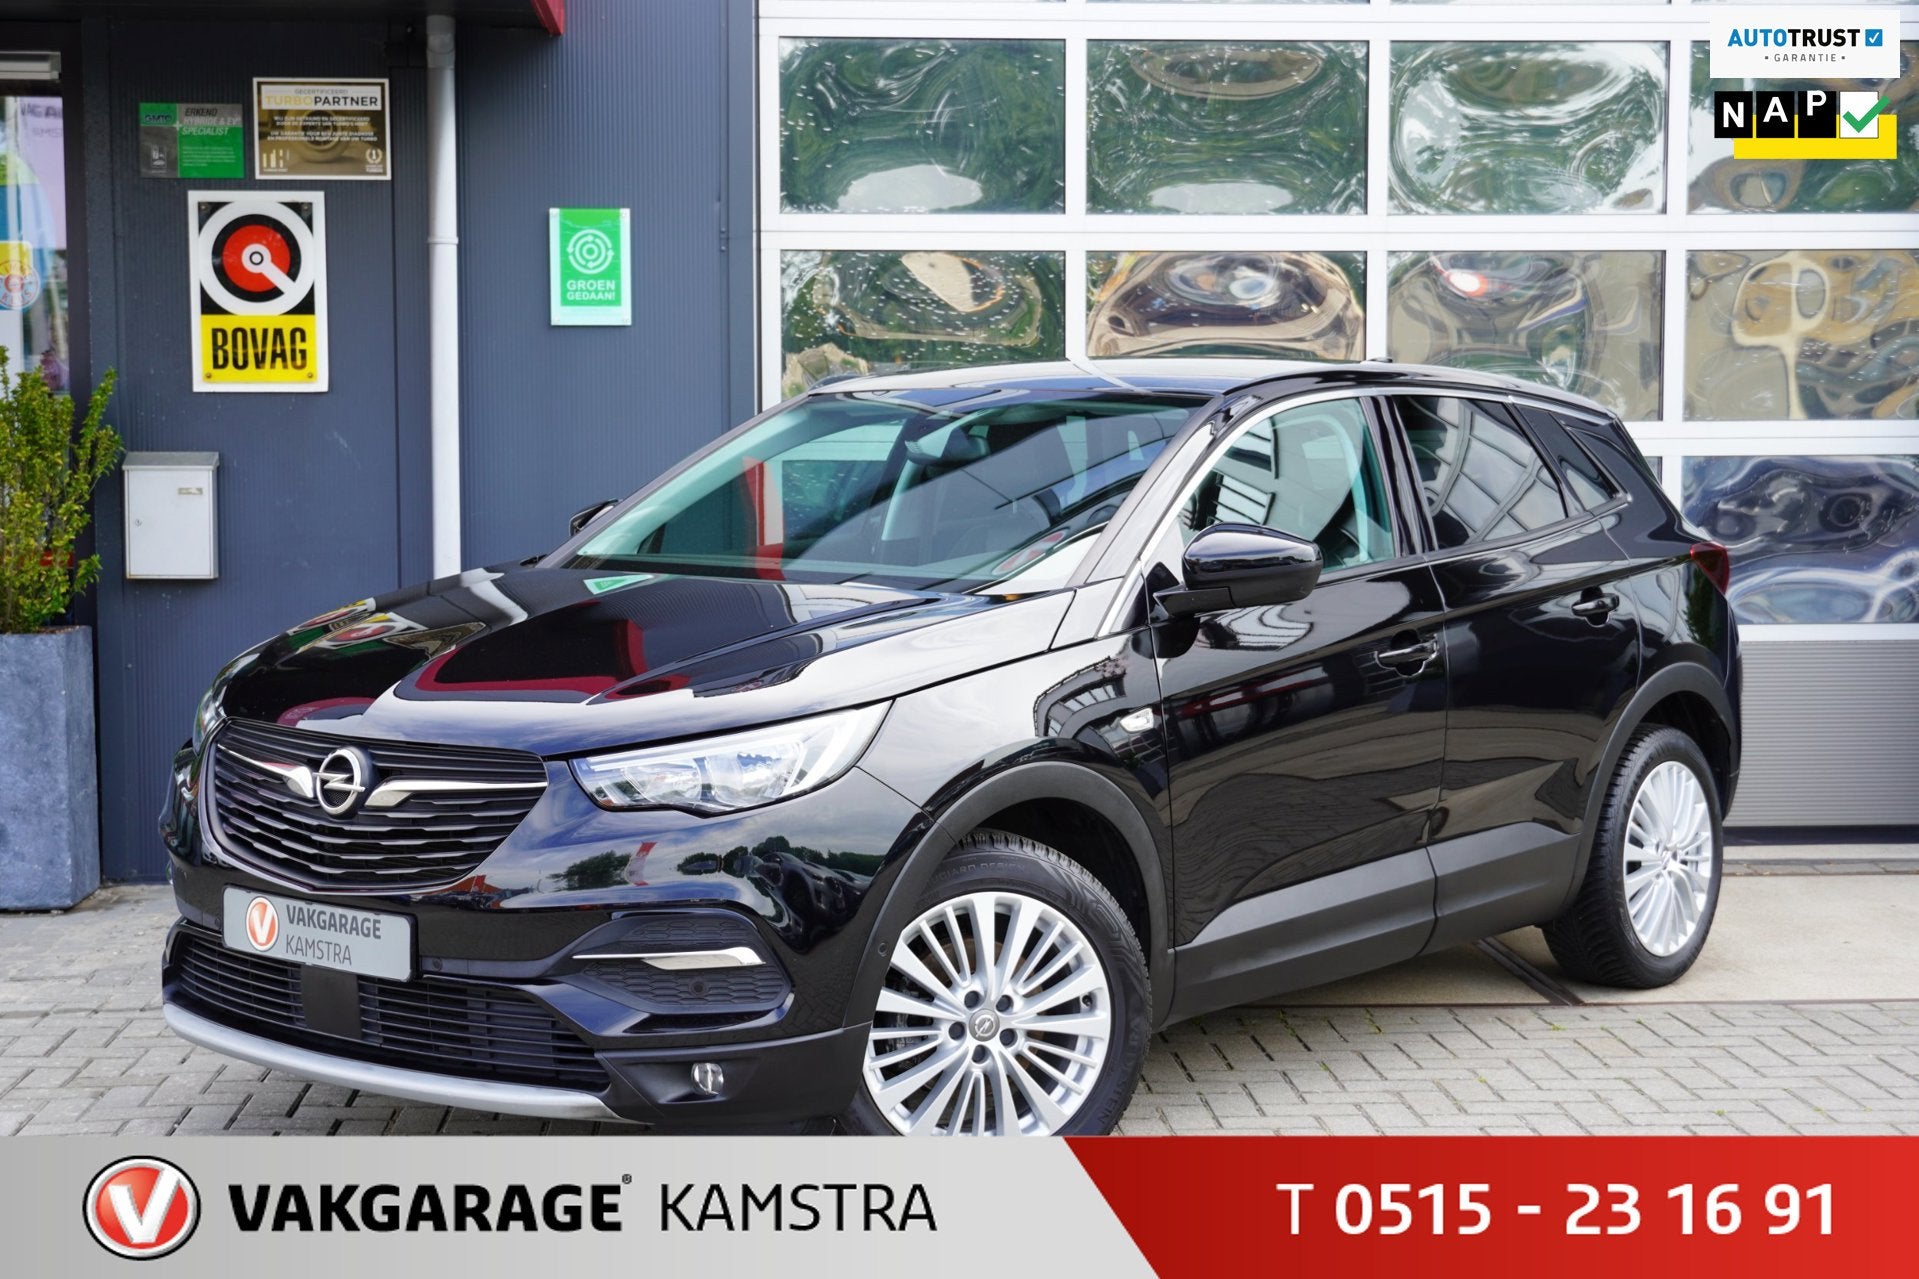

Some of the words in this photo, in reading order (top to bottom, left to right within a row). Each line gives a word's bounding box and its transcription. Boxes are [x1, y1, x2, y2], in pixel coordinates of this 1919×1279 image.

[185, 107, 218, 117] ERKEND
[181, 127, 229, 136] SPECIALIST
[566, 280, 616, 291] GROEN
[566, 291, 616, 301] GEDAAN!
[211, 326, 307, 371] BOVAG
[286, 904, 382, 939] VAKGARAGE
[285, 934, 352, 966] KAMSTRA
